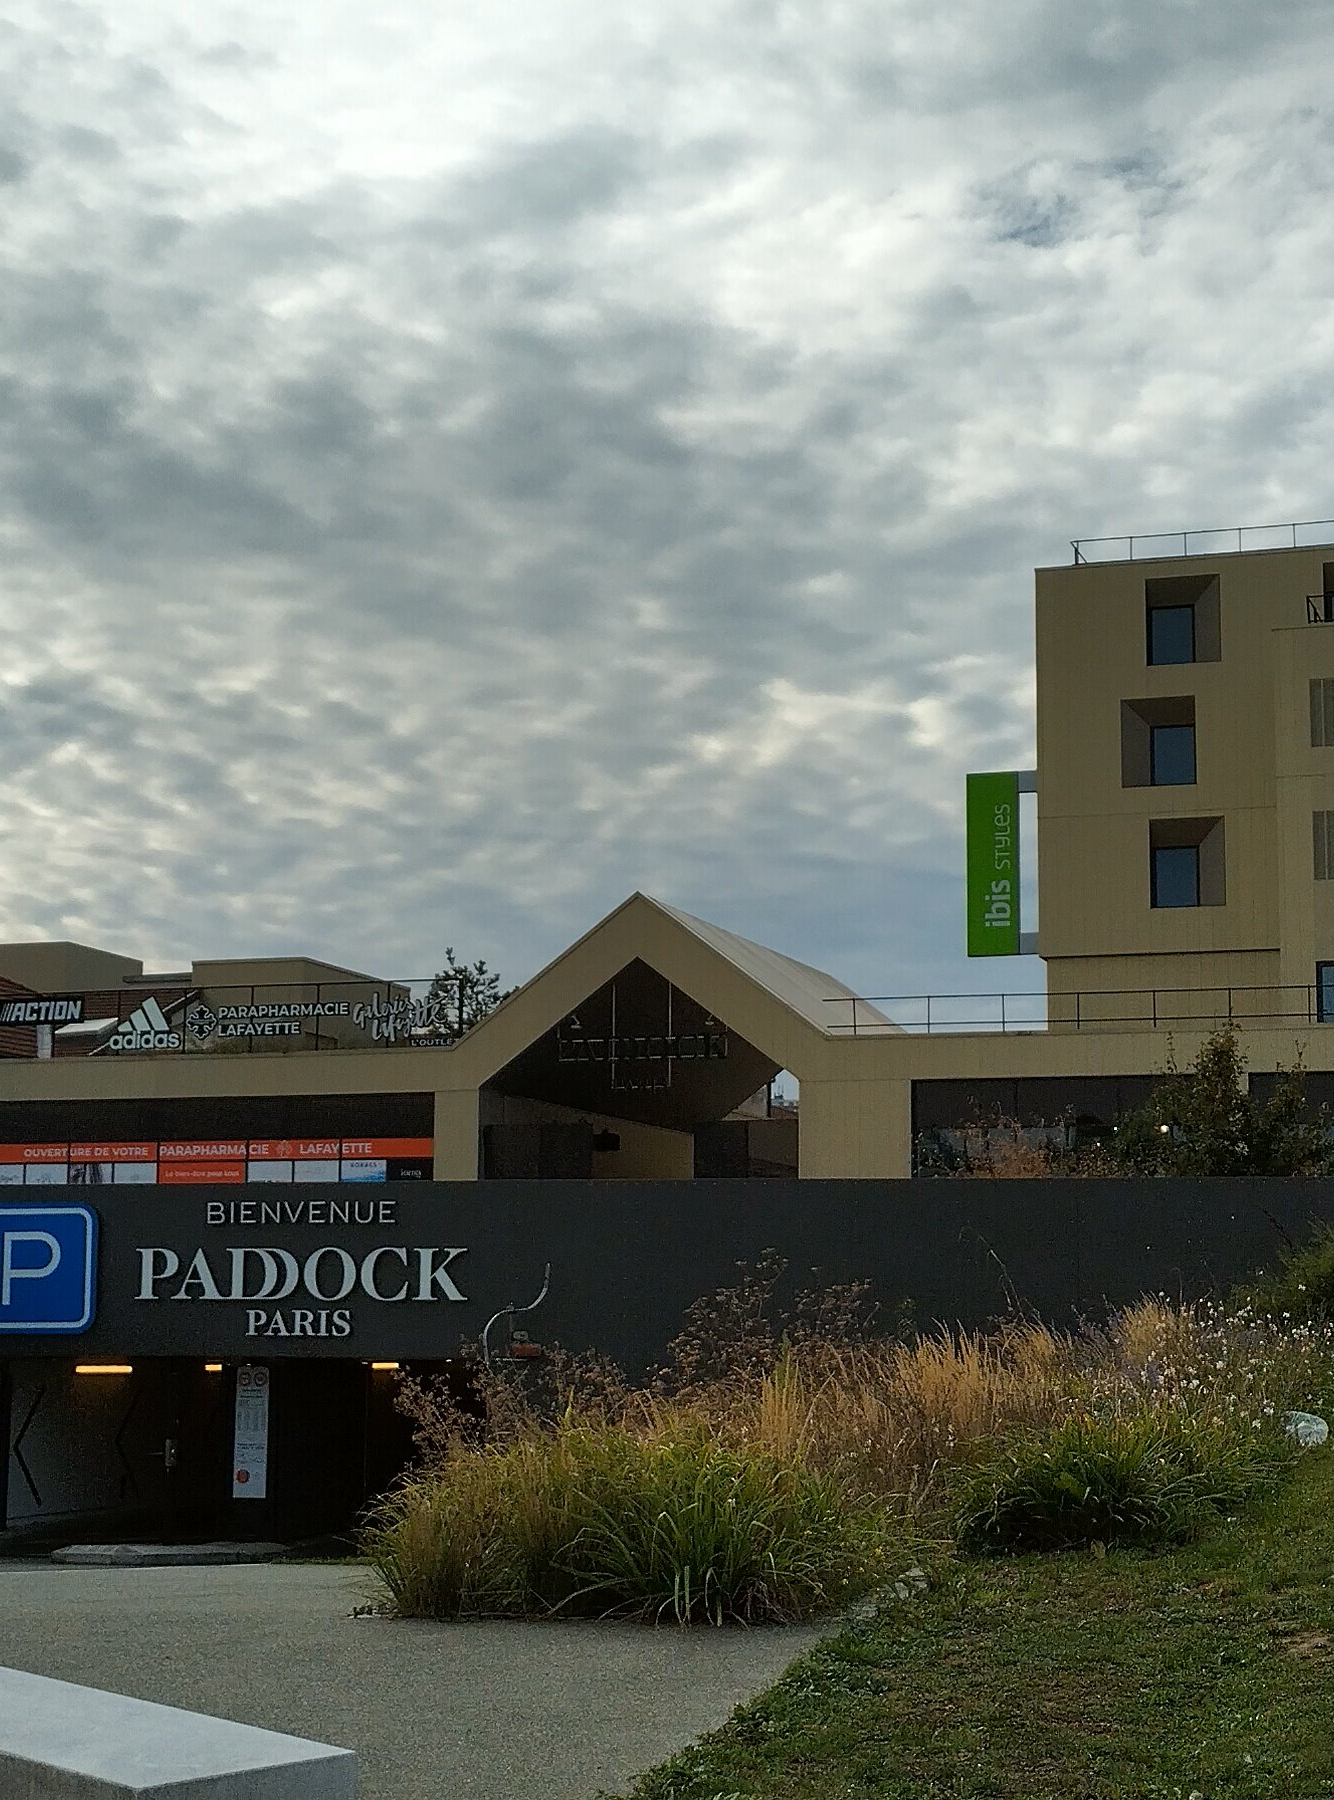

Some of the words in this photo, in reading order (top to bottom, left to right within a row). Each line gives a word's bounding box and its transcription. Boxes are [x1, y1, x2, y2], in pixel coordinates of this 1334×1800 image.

[984, 879, 1012, 928] ibis
[11, 1000, 82, 1022] ACTION
[218, 1002, 349, 1019] PARAPHARMACIE
[218, 1021, 301, 1037] LAFAYETTE
[108, 1031, 181, 1050] adidas
[411, 1038, 454, 1047] L'OUTLE
[24, 1146, 91, 1158] OUVERTURE
[93, 1146, 108, 1157] DE
[111, 1146, 149, 1157] VOTRE
[159, 1143, 269, 1157] PARAPHARMACIE
[299, 1142, 373, 1155] LAFAYETTE
[206, 1201, 397, 1225] BIENVENUE
[1, 1231, 62, 1306] P
[133, 1246, 469, 1302] PADDOCK
[245, 1309, 352, 1337] PARIS
